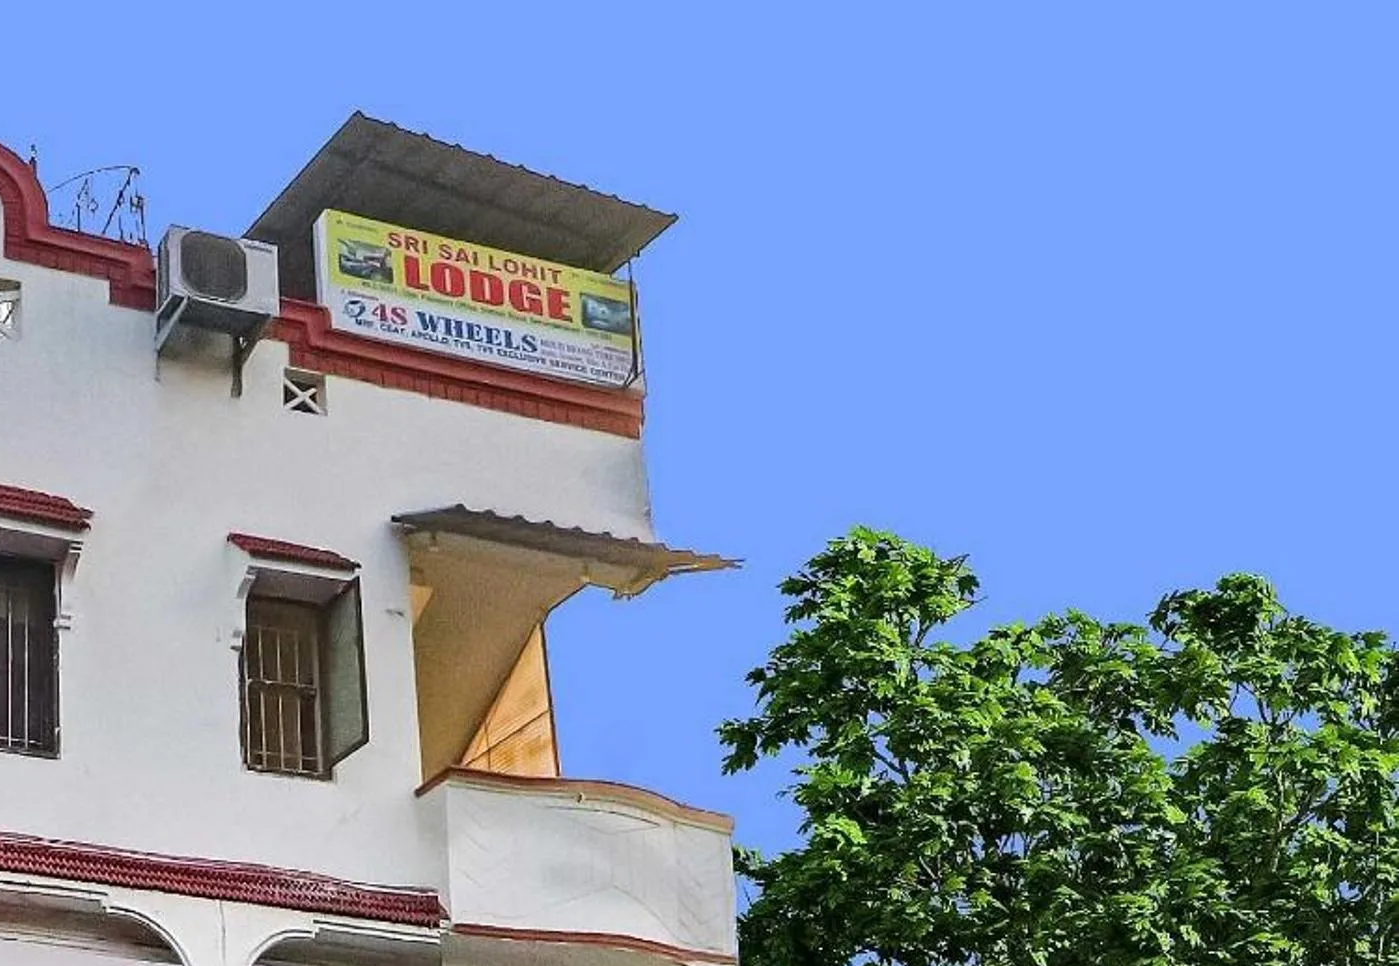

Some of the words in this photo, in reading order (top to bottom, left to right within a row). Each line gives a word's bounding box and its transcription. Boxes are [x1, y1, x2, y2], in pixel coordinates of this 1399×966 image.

[388, 231, 427, 254] SRI
[439, 243, 478, 266] SAI
[489, 253, 562, 285] LOHIT
[403, 255, 573, 323] LODGE
[372, 303, 408, 326] 4S
[415, 311, 538, 353] WHEELS
